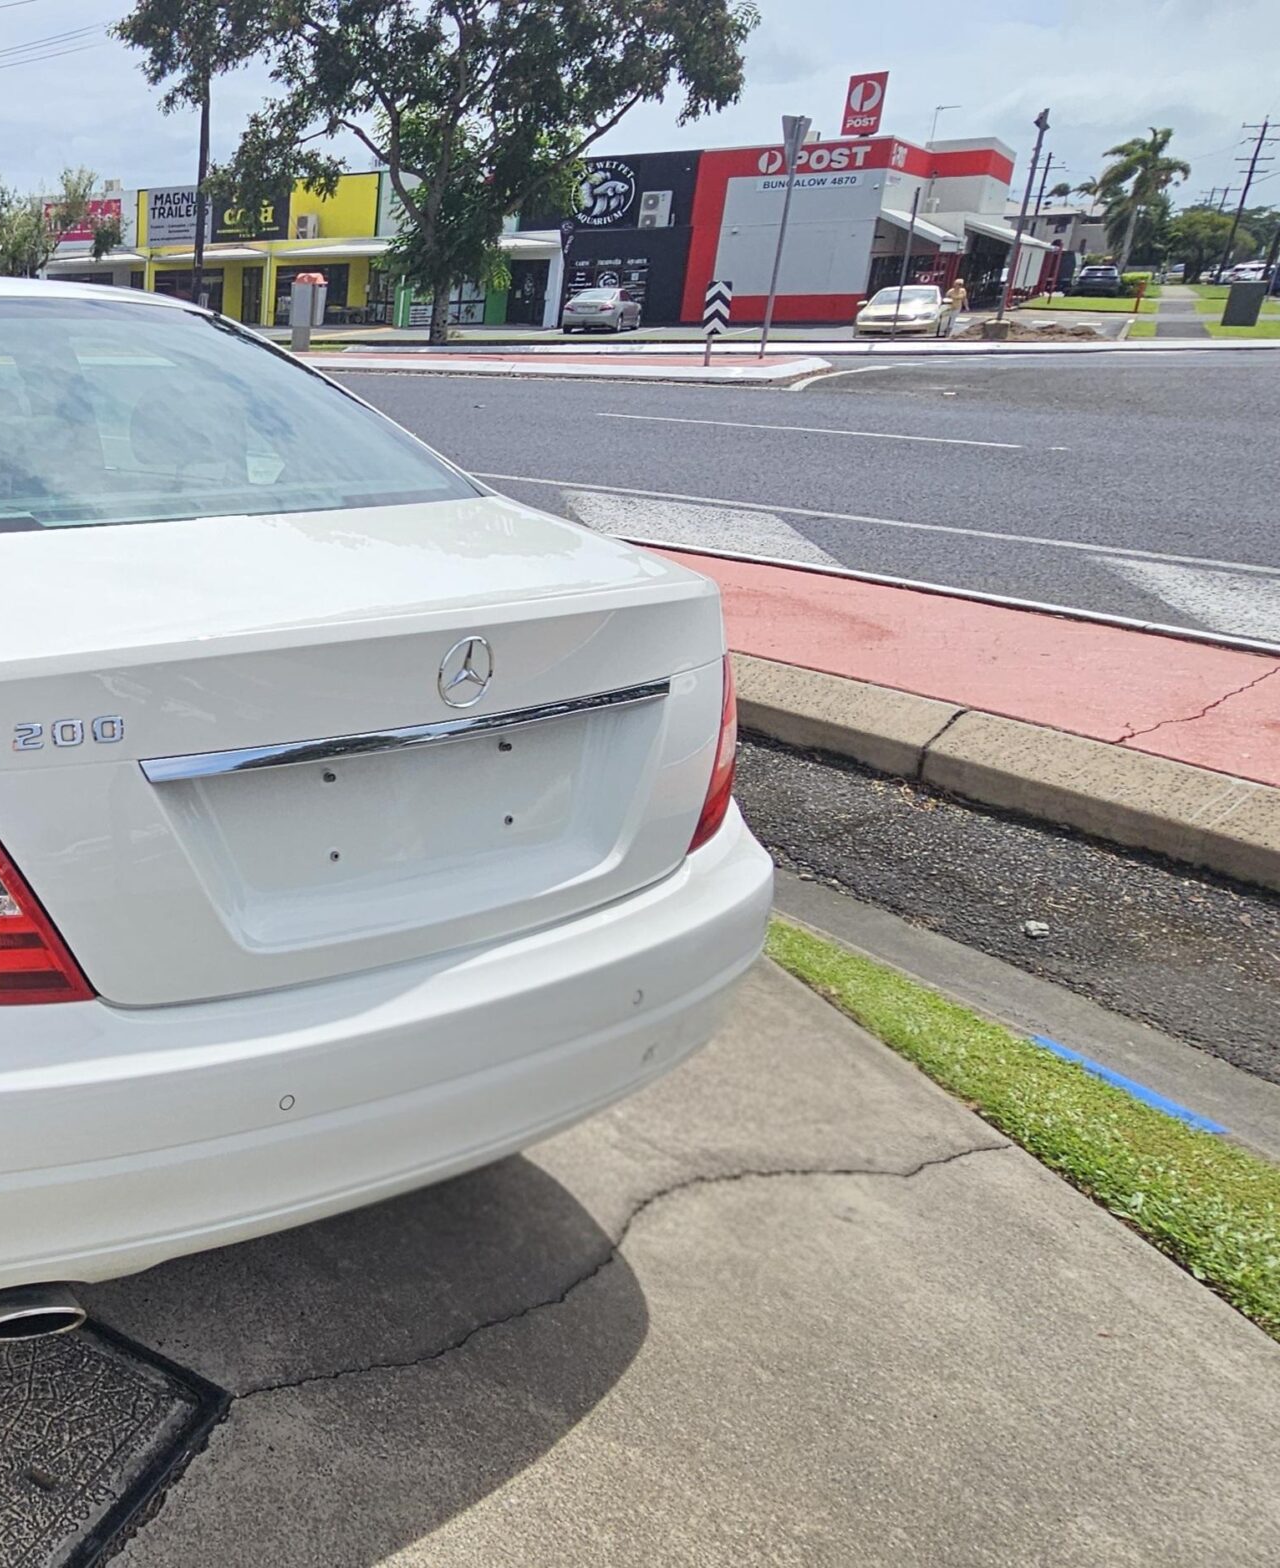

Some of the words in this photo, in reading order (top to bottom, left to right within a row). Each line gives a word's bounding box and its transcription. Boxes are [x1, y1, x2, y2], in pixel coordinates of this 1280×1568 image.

[846, 116, 877, 128] POST
[794, 146, 872, 170] POST
[596, 160, 619, 169] WET
[617, 163, 635, 179] PET
[830, 175, 858, 186] 4870
[575, 210, 623, 225] AQUARIUM
[12, 715, 125, 752] 200
